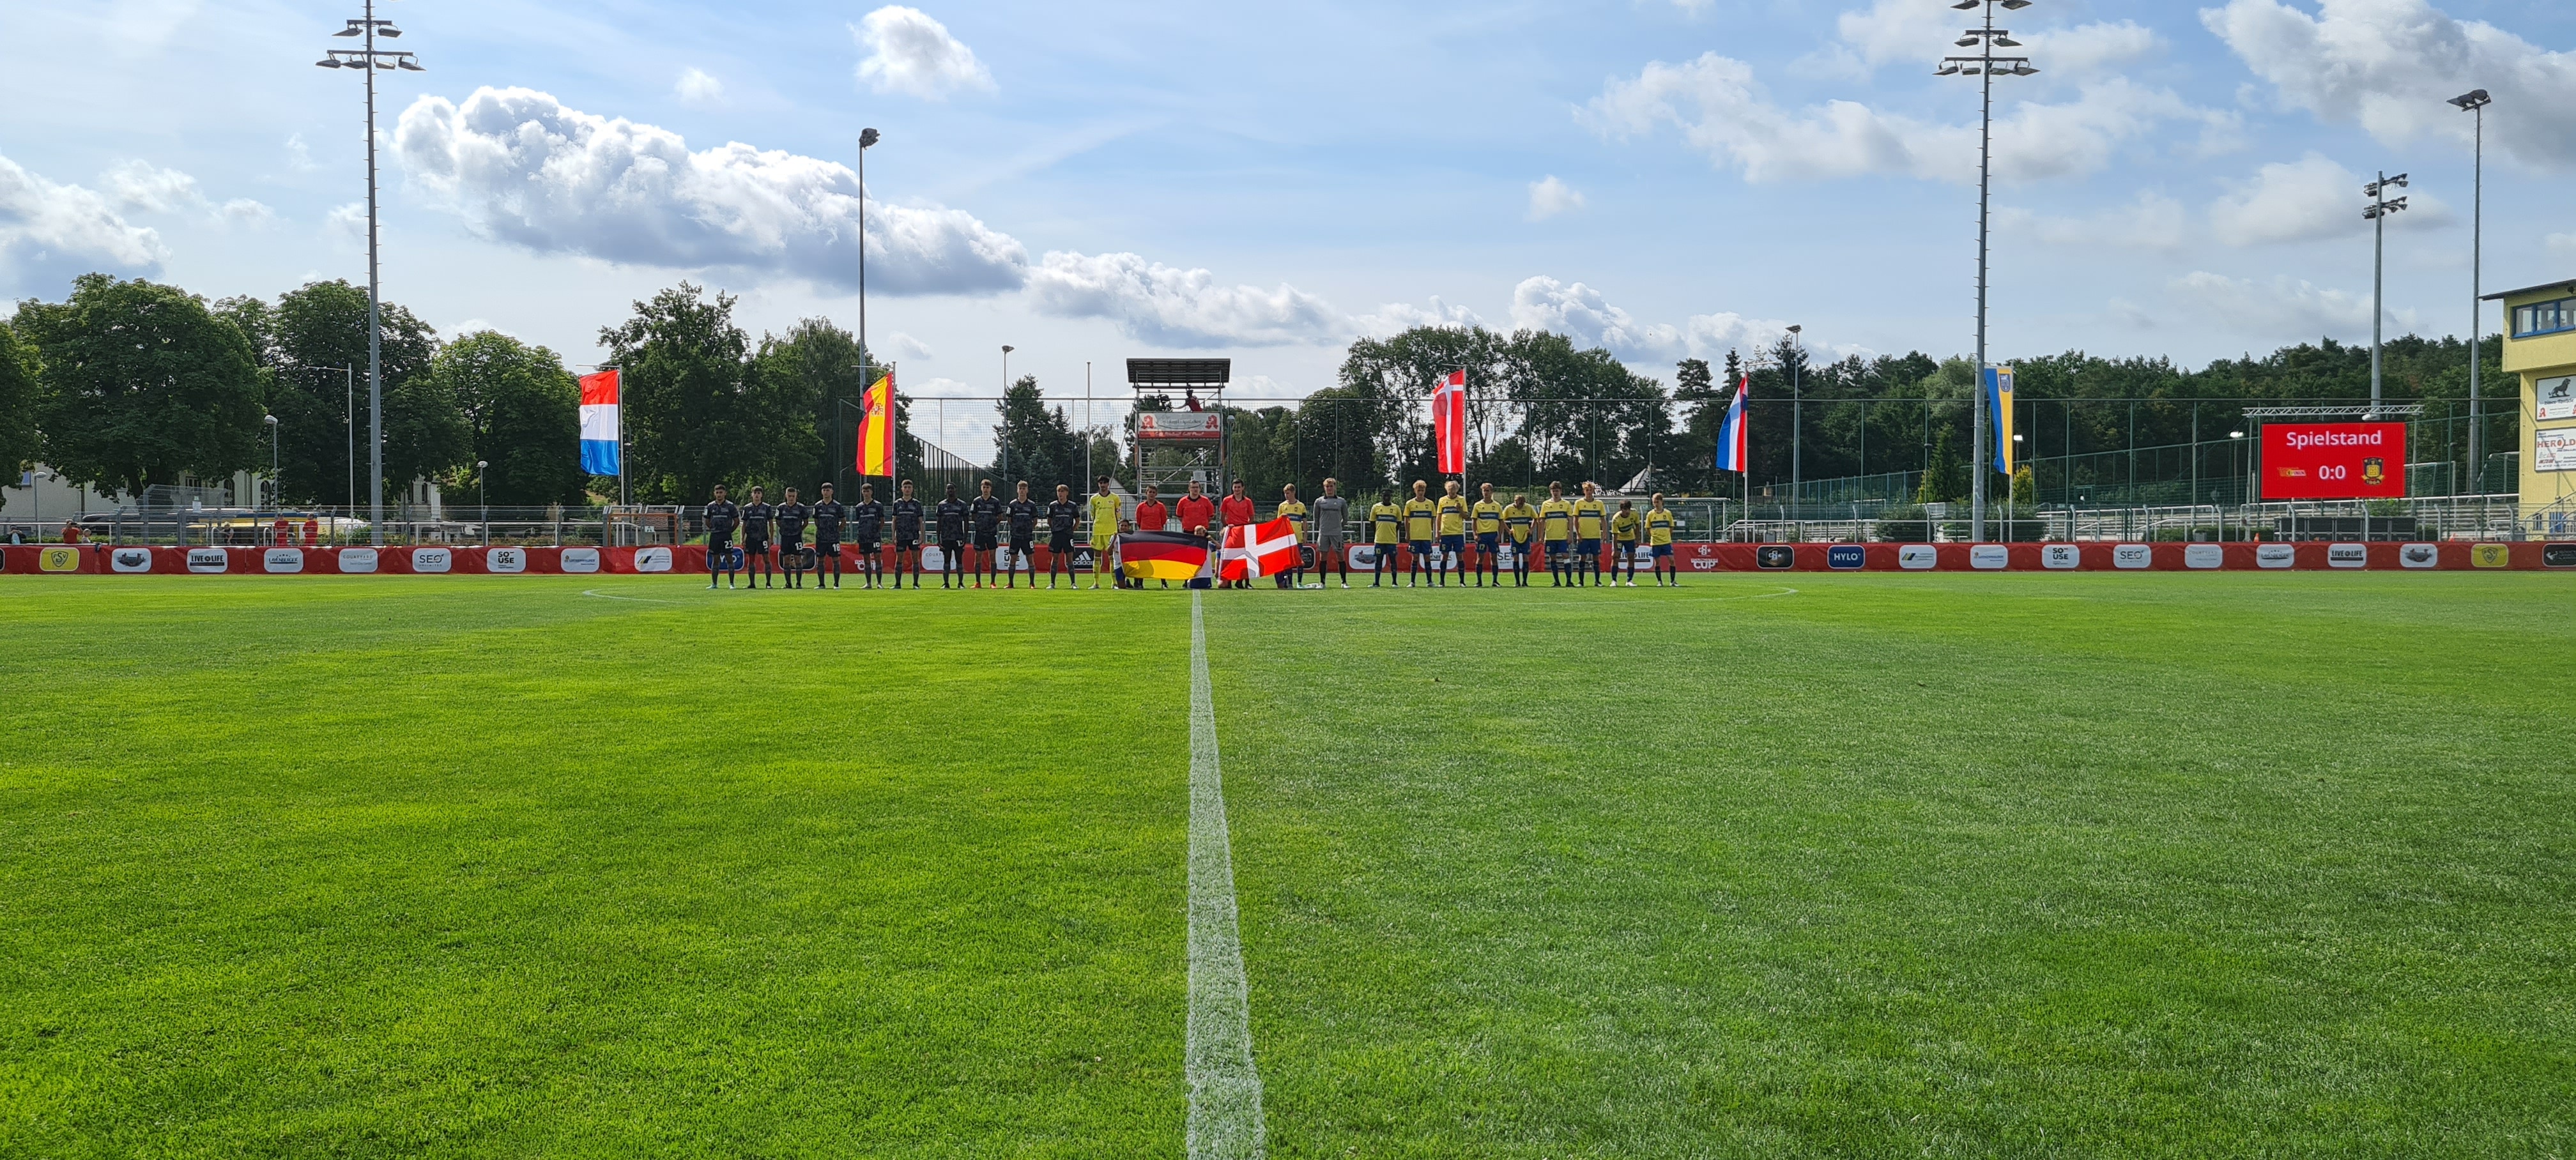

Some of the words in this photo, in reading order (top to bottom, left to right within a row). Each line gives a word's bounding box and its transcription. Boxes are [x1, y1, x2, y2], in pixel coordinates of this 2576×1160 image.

[2286, 430, 2382, 450] Spielstand
[2319, 465, 2346, 480] 0:0
[724, 540, 733, 549] 23
[762, 540, 768, 549] 9
[795, 542, 803, 551] 13
[832, 543, 840, 551] 18
[1029, 540, 1034, 549] 8
[419, 554, 443, 563] SEO
[1834, 553, 1859, 561] HYLO
[2120, 551, 2143, 560] SEO
